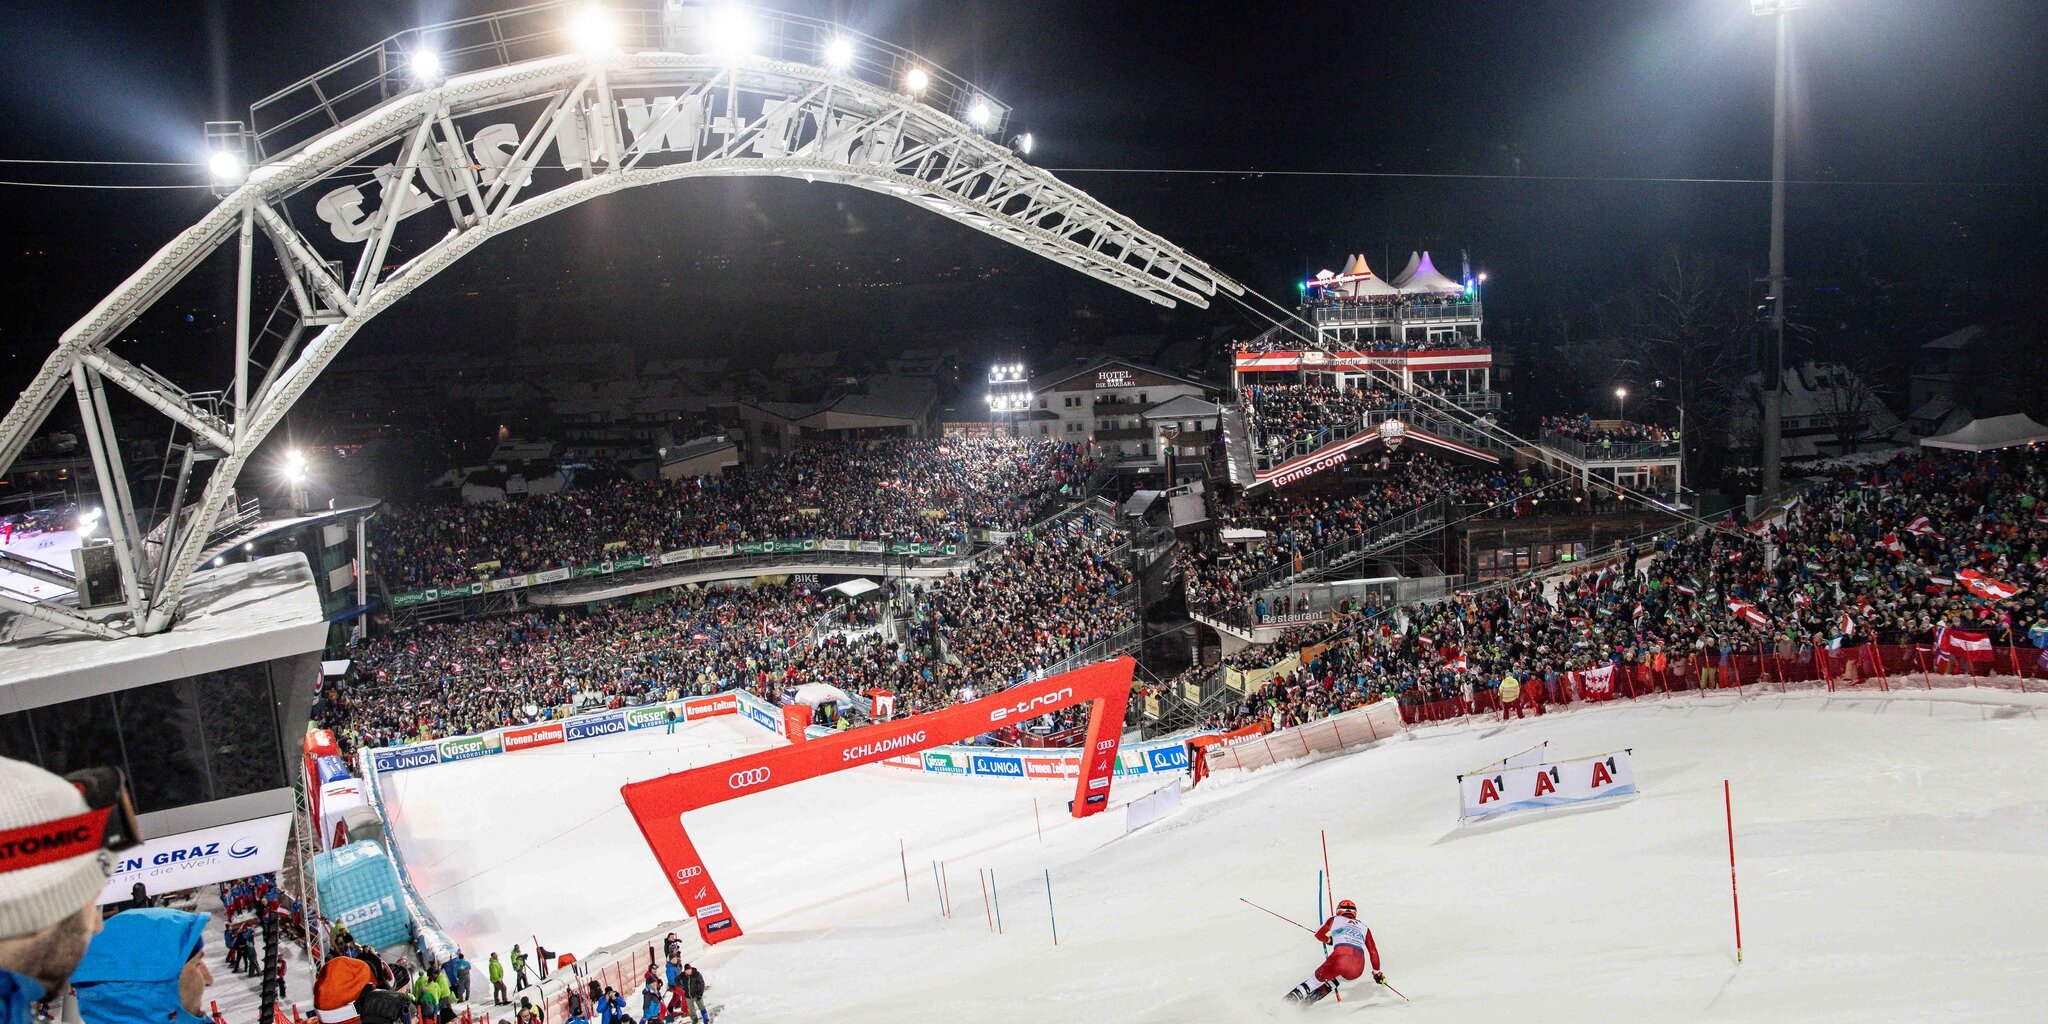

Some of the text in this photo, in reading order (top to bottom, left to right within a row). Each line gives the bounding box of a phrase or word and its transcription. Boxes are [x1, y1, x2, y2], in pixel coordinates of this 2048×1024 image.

[1098, 371, 1132, 380] HOTEL
[1272, 452, 1347, 487] tenne.com
[794, 573, 818, 583] BIKE
[1262, 610, 1323, 624] Restaurant
[687, 704, 713, 716] Kronen
[990, 687, 1073, 722] e-tron
[627, 710, 666, 728] Gösser
[586, 721, 626, 736] UNIQA
[505, 727, 563, 747] Kronen Zeitung
[440, 740, 483, 758] Gösser
[843, 730, 927, 762] SCHLADMING
[396, 754, 438, 769] UNIQA
[455, 749, 495, 760] ALKOHOLFREI
[926, 753, 947, 769] Gösser
[990, 761, 1021, 774] UNIQA
[1027, 759, 1052, 773] Kronen
[1479, 756, 1617, 805] A1 A1 A1
[115, 842, 221, 873] EN GRAZ
[124, 872, 142, 883] ist
[150, 865, 174, 877] die
[181, 857, 222, 872] Welt.
[346, 903, 378, 923] ORF
[1345, 926, 1361, 937] 22
